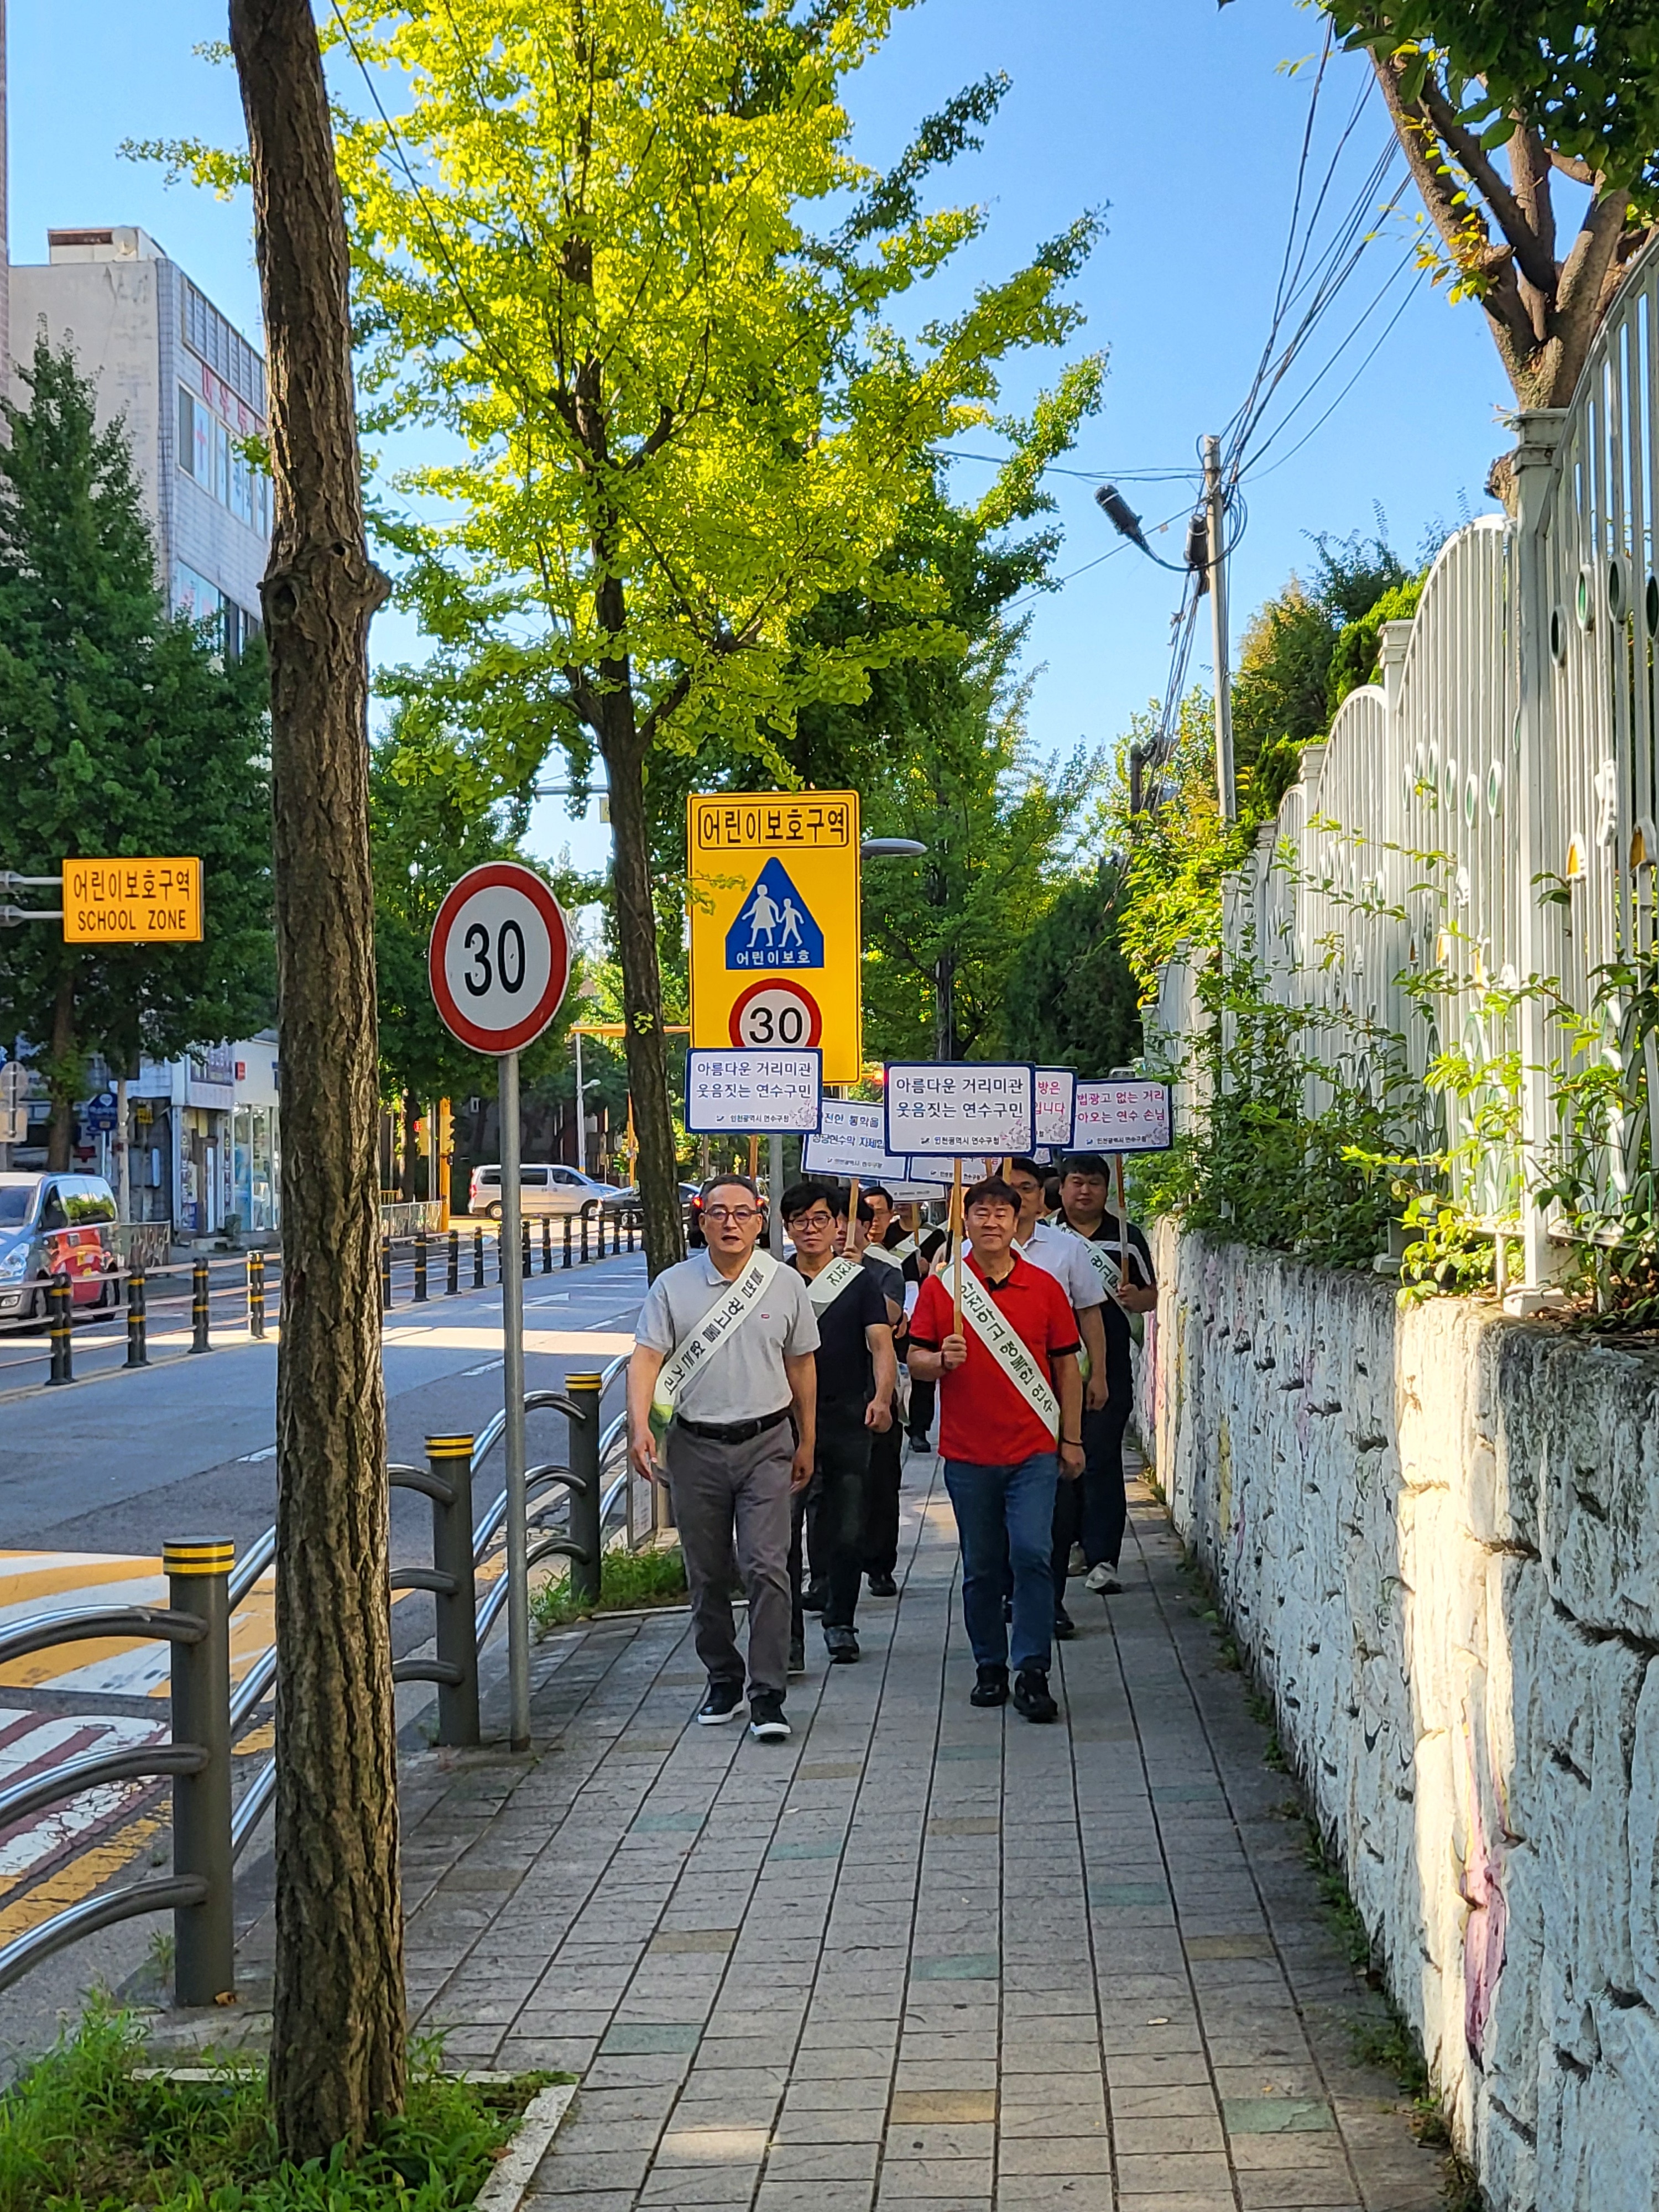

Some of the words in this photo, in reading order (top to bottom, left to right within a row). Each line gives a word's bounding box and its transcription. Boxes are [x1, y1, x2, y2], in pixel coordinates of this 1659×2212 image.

[703, 807, 844, 844] 어린이보호구역
[74, 869, 190, 902] 어린이보호구역
[78, 910, 137, 931] SCHOOL
[148, 909, 186, 930] ZONE
[464, 920, 525, 997] 30
[737, 950, 810, 966] 어린이보호
[749, 1007, 802, 1044] 30
[697, 1062, 752, 1076] 아름다운
[757, 1061, 812, 1077] 거리미관
[696, 1083, 751, 1098] 웃음짓는
[756, 1084, 811, 1098] 연수구민
[896, 1078, 956, 1094] 아름다운
[962, 1078, 1023, 1094] 거리미관
[1036, 1081, 1061, 1094] 방은
[1077, 1093, 1112, 1106] 법광고
[1116, 1092, 1139, 1104] 없는
[1143, 1089, 1165, 1102] 거리
[896, 1102, 957, 1118] 웃음짓는
[963, 1102, 1023, 1118] 연수구민
[1075, 1111, 1113, 1124] 아오는
[1116, 1110, 1139, 1123] 연수
[1143, 1108, 1165, 1121] 손님
[824, 1113, 844, 1125] 전한
[961, 1281, 1006, 1340] 안전하고
[1031, 1384, 1053, 1413] 연수
[664, 1364, 686, 1395] 거리
